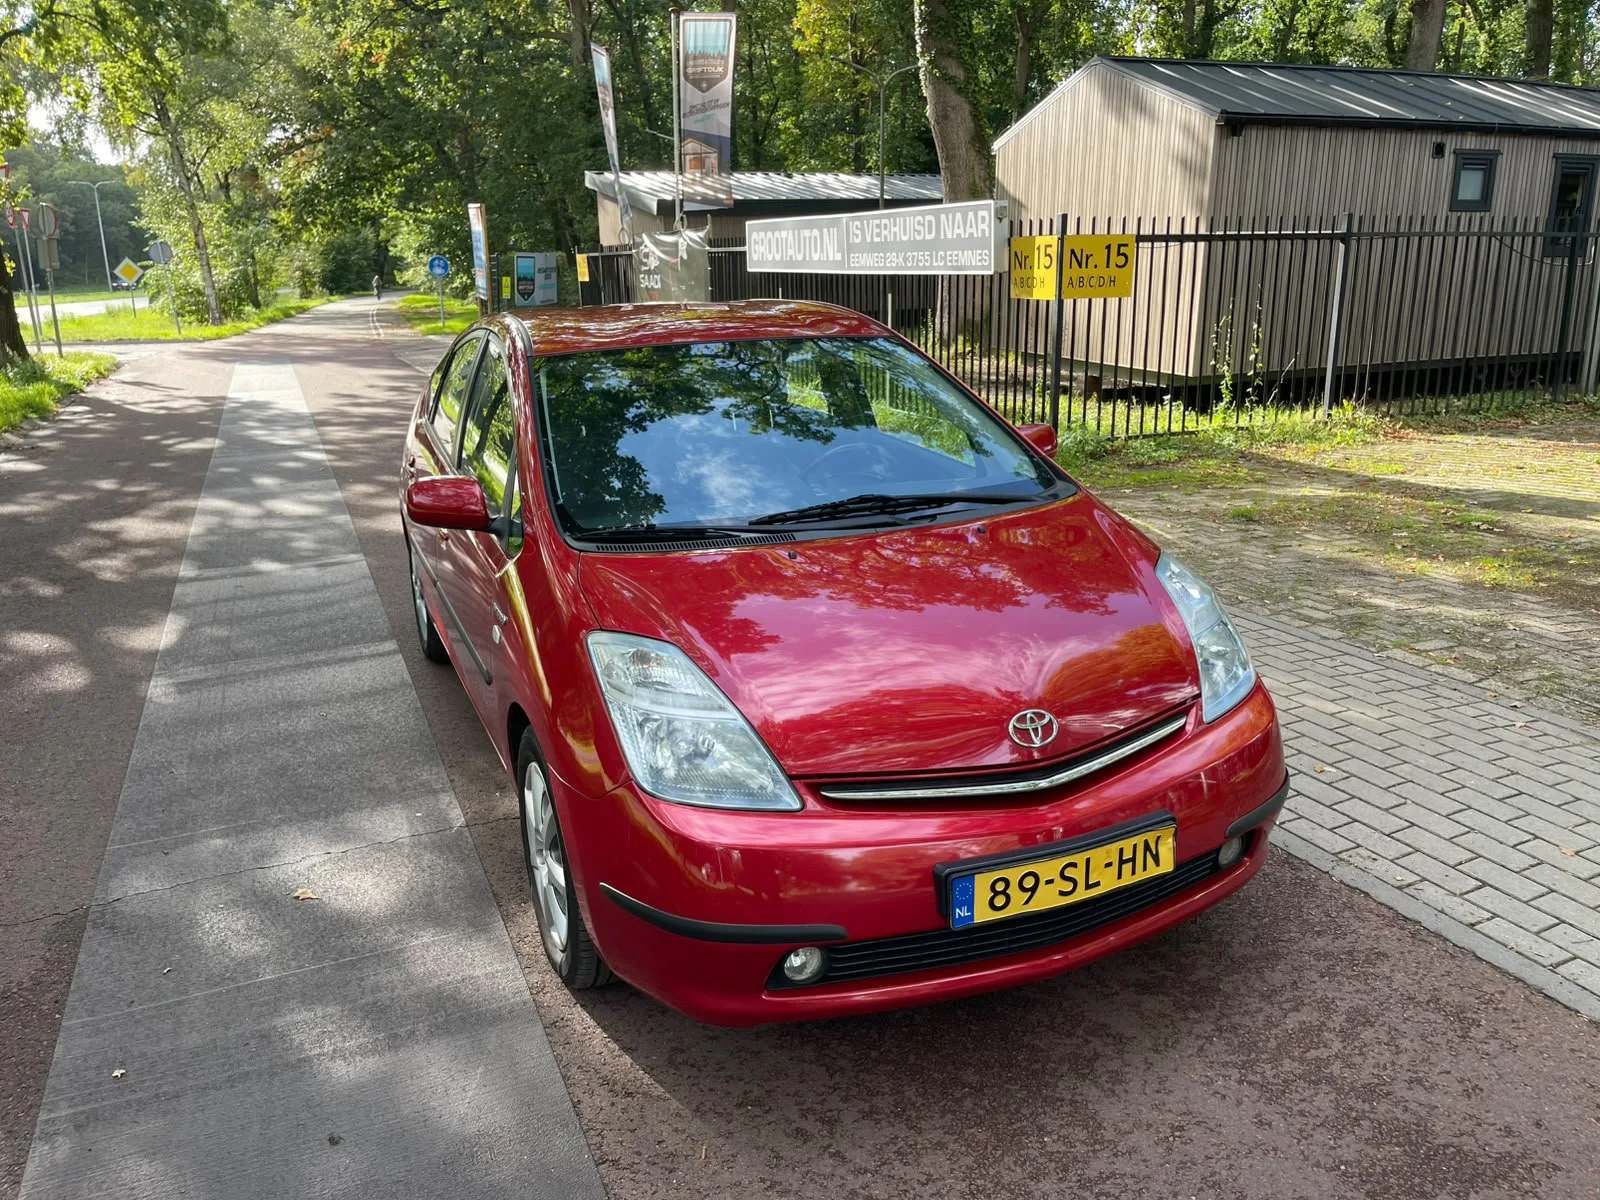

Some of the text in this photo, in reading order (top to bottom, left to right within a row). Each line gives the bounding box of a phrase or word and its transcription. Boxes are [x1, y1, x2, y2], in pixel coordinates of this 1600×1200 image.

[849, 210, 990, 243] IS VERHUISD NAAR
[751, 227, 842, 261] GROOTAUTO.NL
[1013, 244, 1053, 270] Nr. 15
[1068, 243, 1129, 270] Nr. 15
[850, 249, 989, 267] EEMWEG 29-K 3755 LC EEMNES
[987, 834, 1162, 912] 89-SL-HN
[955, 906, 971, 919] NL
